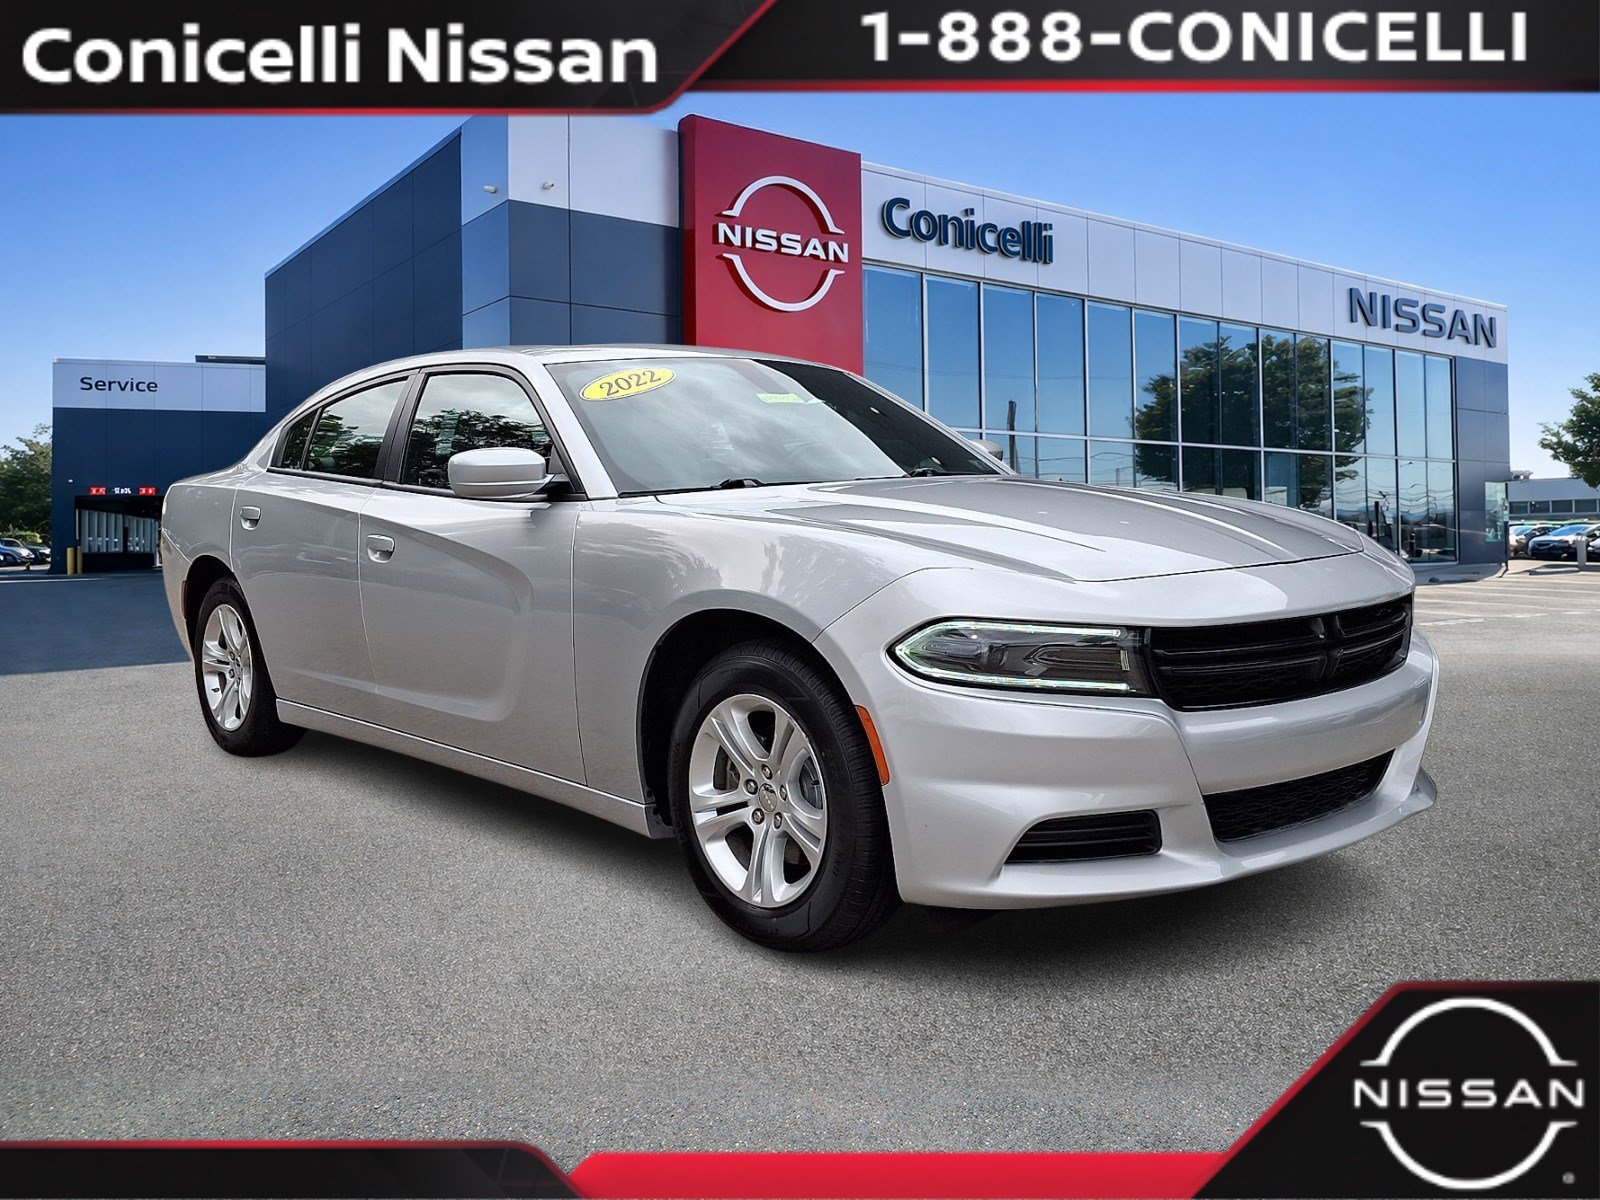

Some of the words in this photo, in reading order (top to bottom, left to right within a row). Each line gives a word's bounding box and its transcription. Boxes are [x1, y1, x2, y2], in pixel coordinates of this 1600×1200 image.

[716, 222, 849, 263] NISSAN
[881, 197, 1054, 264] Conicelli
[1348, 287, 1497, 348] NISSAN
[79, 376, 158, 392] Service
[600, 370, 661, 396] 2022
